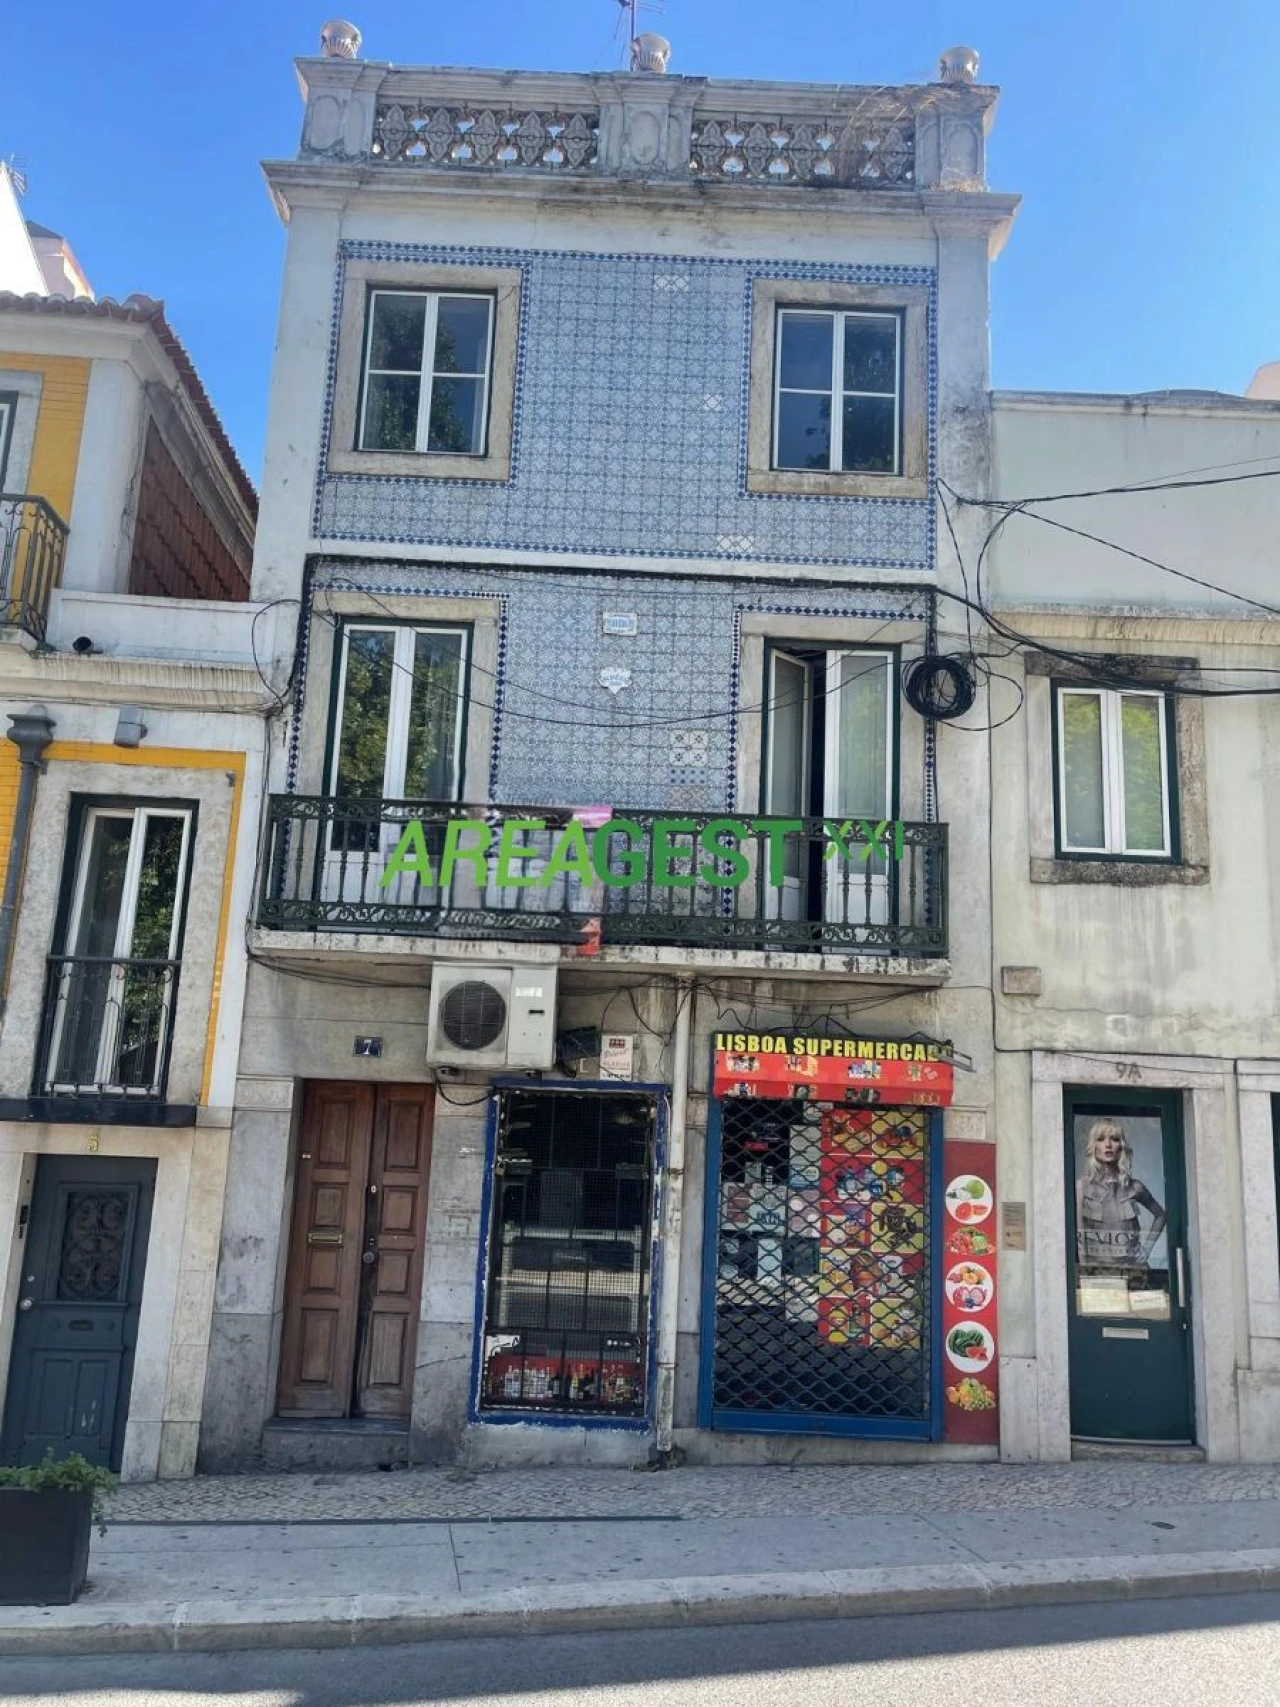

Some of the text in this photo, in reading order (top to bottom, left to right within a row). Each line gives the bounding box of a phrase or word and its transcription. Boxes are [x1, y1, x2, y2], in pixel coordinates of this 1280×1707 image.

[363, 1039, 372, 1055] 7
[716, 1033, 787, 1053] LISBOA
[1115, 1061, 1143, 1079] 9A
